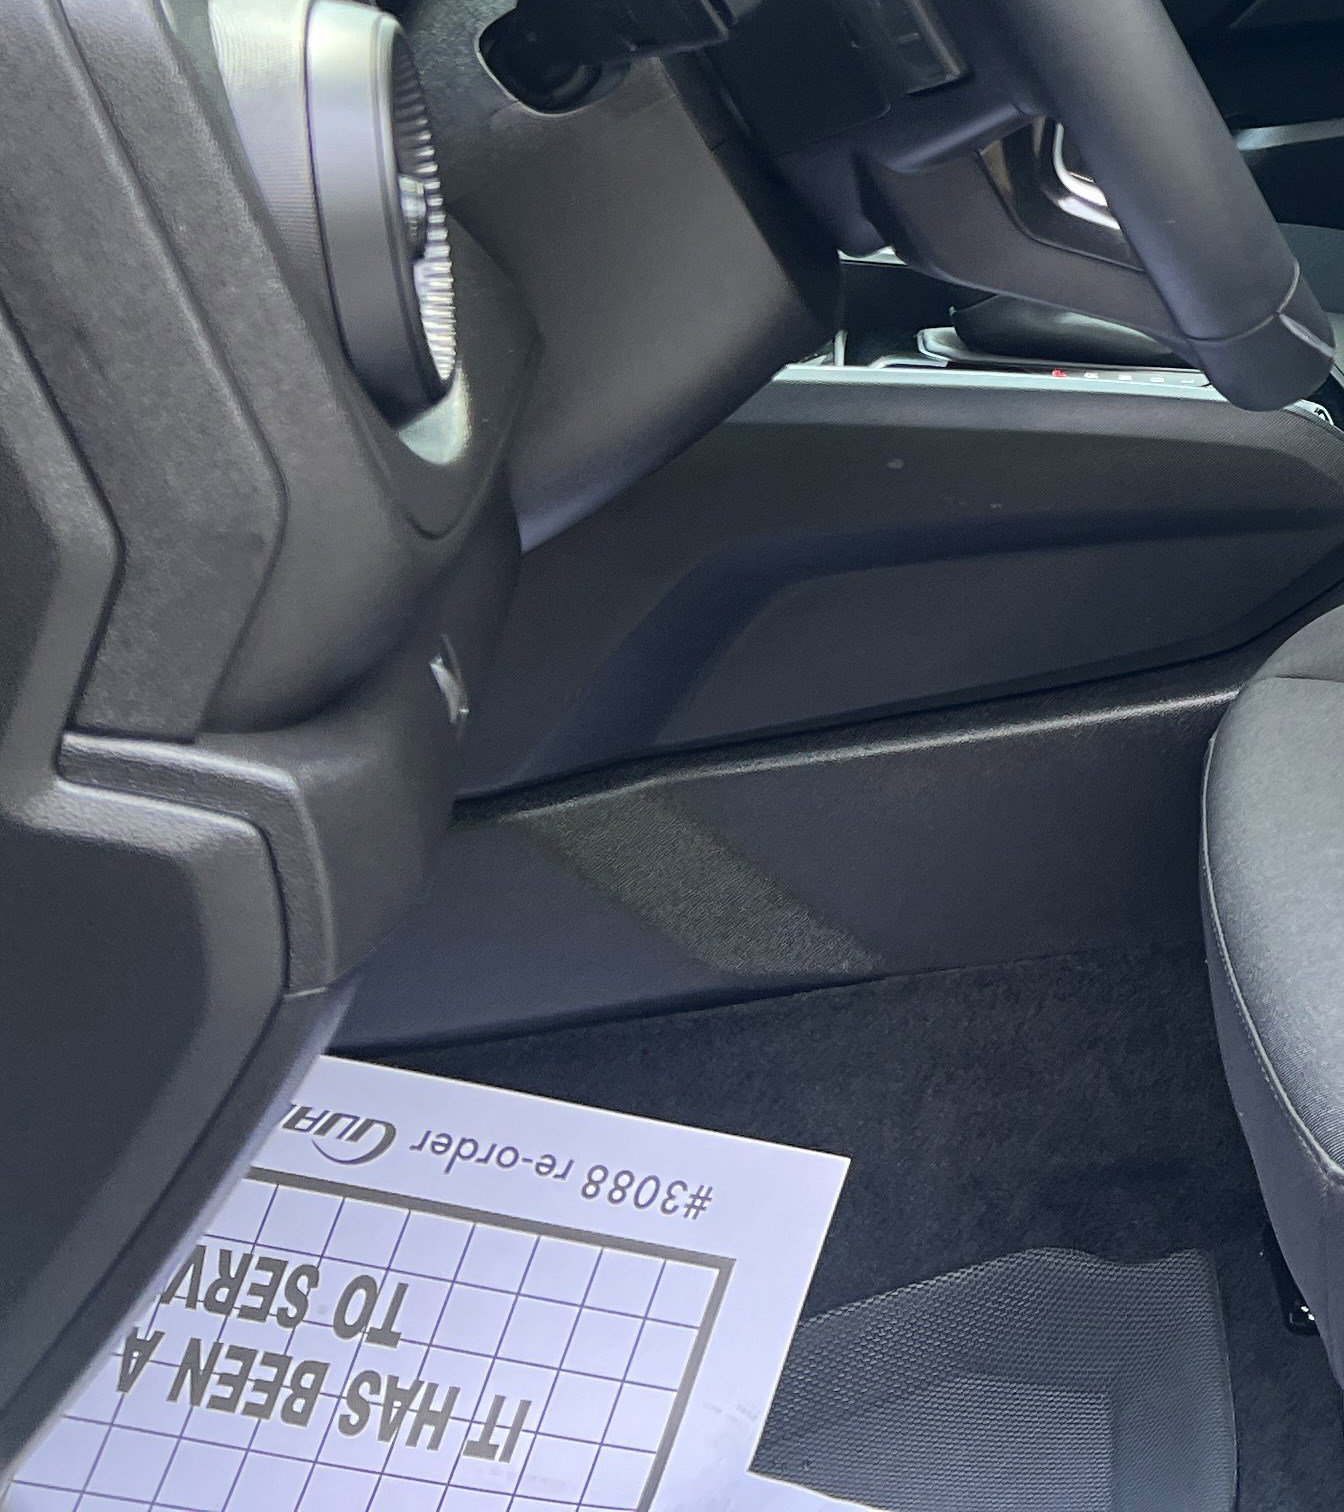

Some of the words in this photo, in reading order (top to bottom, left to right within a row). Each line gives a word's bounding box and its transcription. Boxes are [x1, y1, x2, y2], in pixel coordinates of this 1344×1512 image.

[281, 1102, 396, 1165] GUA
[408, 1130, 575, 1180] re-order
[580, 1164, 713, 1221] #3088
[333, 1274, 409, 1349] TO
[116, 1326, 165, 1393] A
[166, 1337, 331, 1426] BEEN
[339, 1369, 461, 1451] HAS
[462, 1395, 533, 1464] IT
